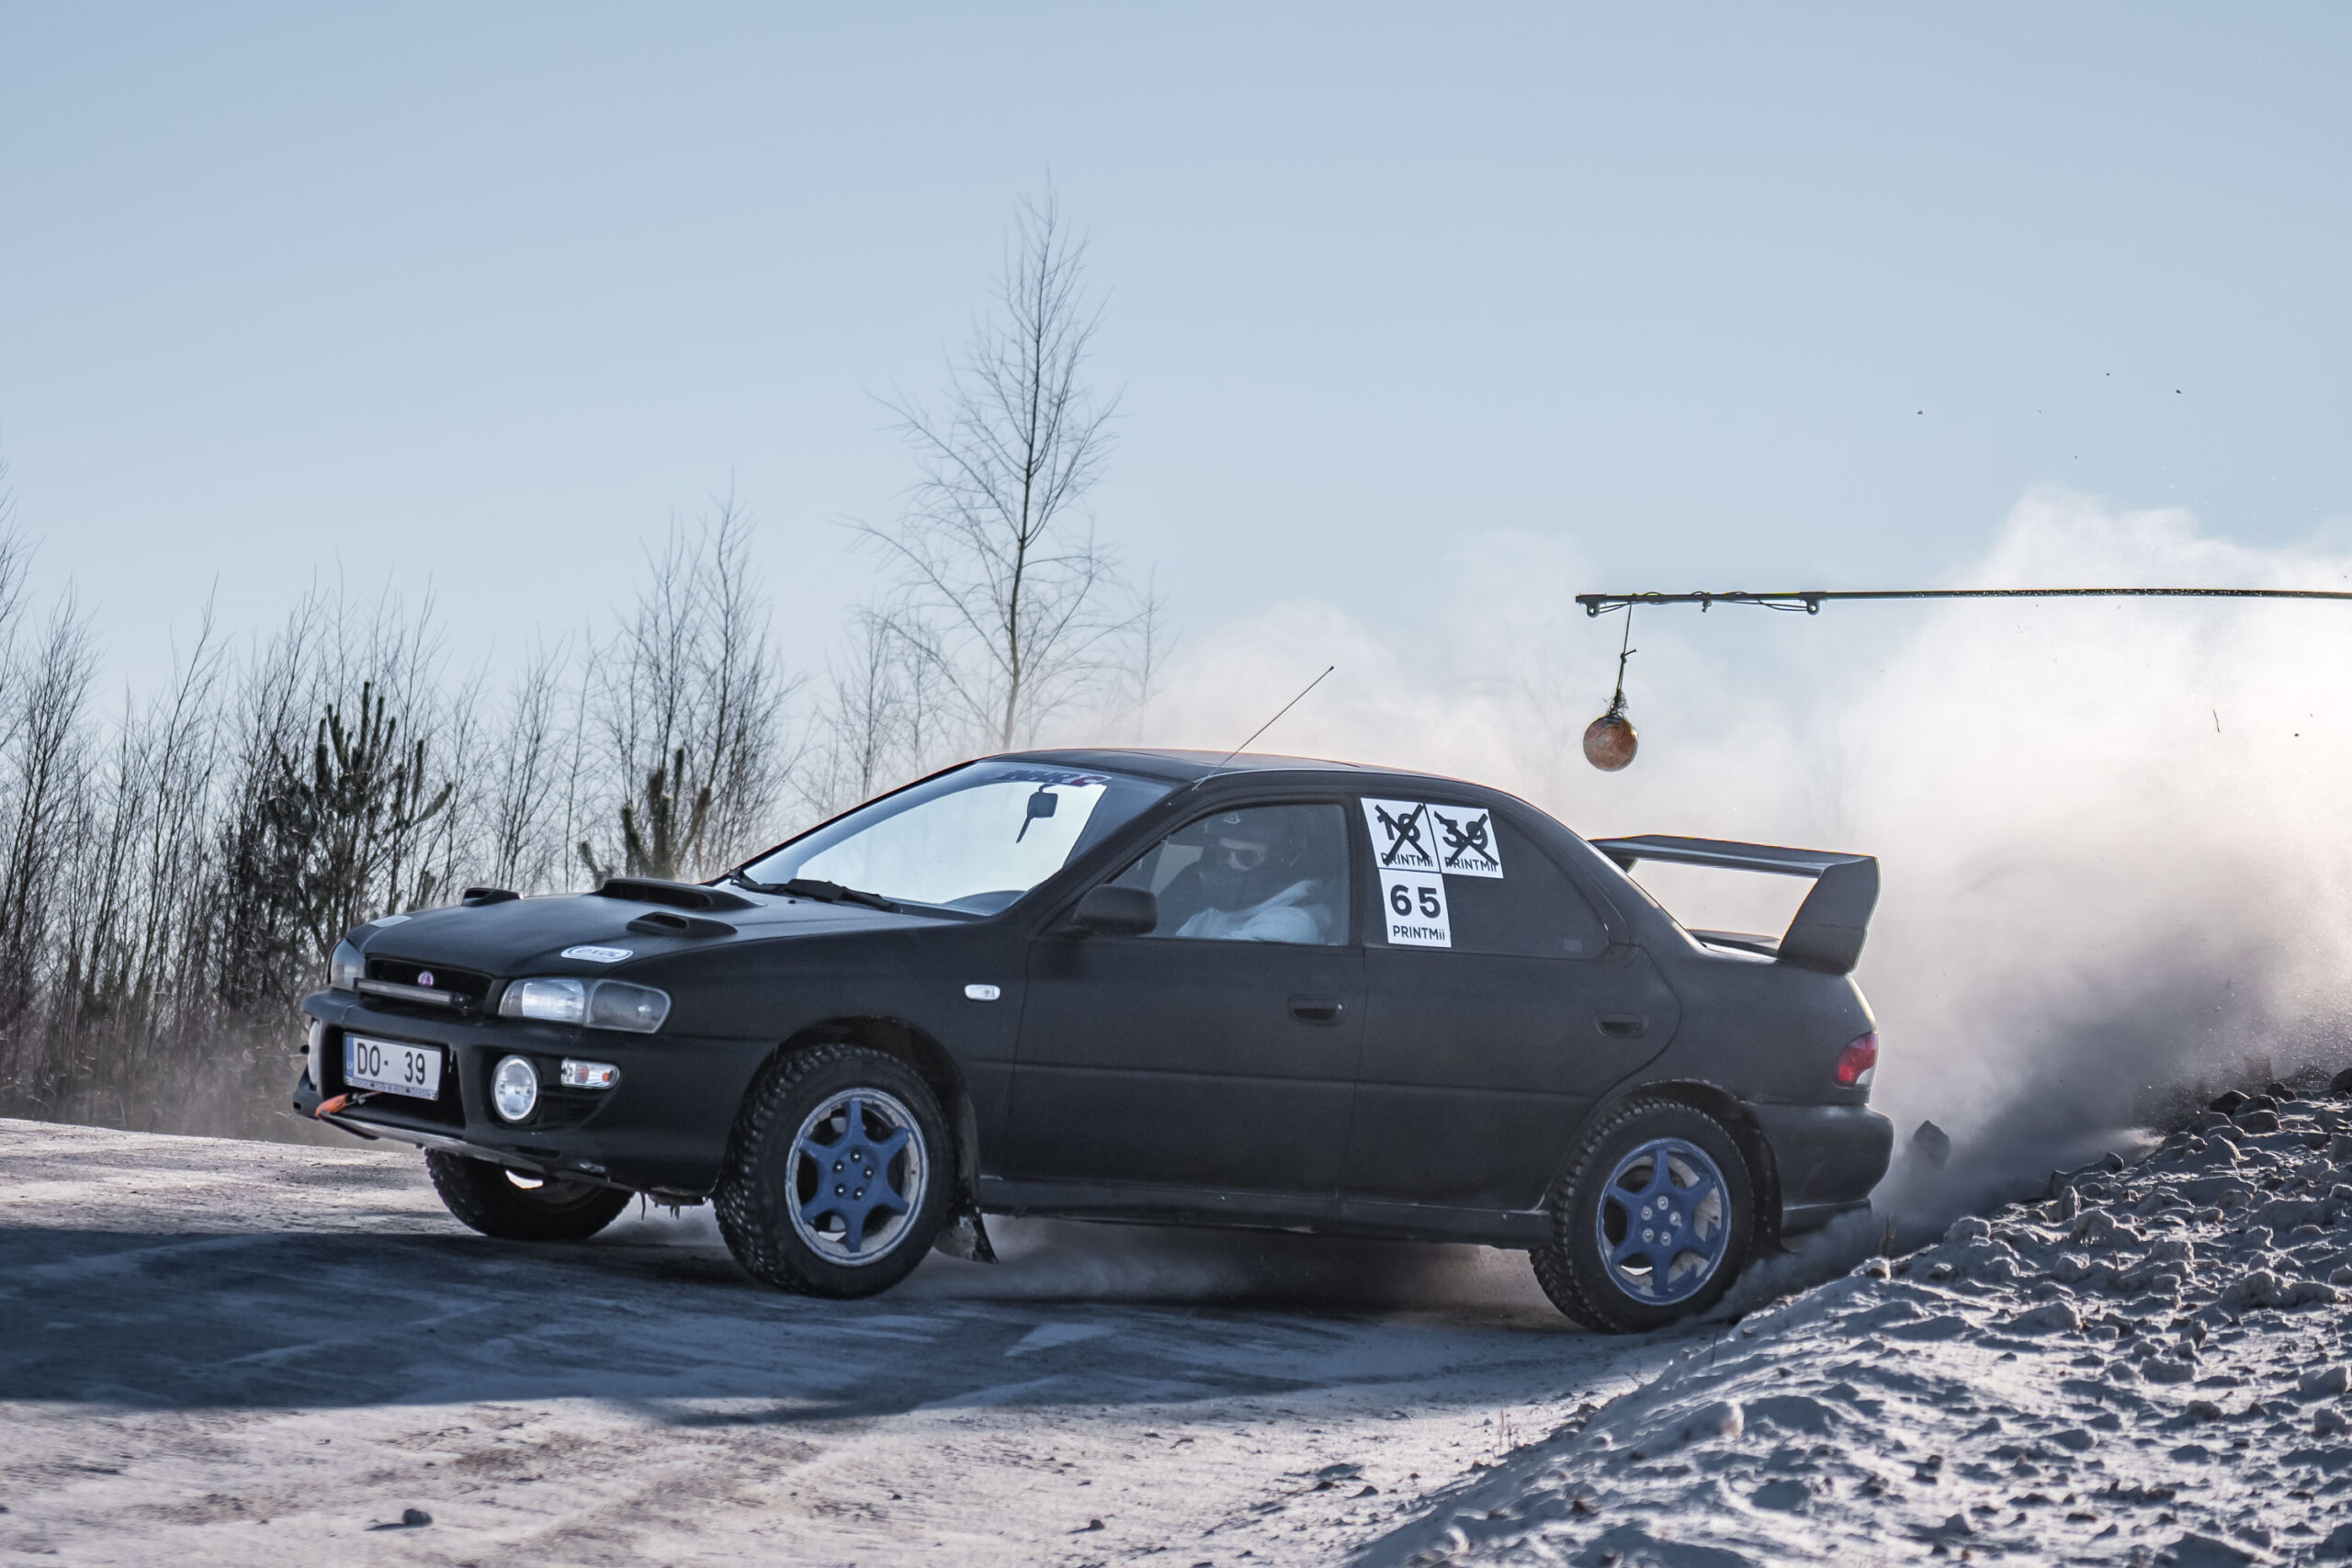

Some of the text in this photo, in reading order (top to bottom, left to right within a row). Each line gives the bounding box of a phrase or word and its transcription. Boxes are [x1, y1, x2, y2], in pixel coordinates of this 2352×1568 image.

[1390, 884, 1442, 919] 65
[1393, 925, 1445, 941] PRINTMii
[404, 1051, 425, 1085] 39
